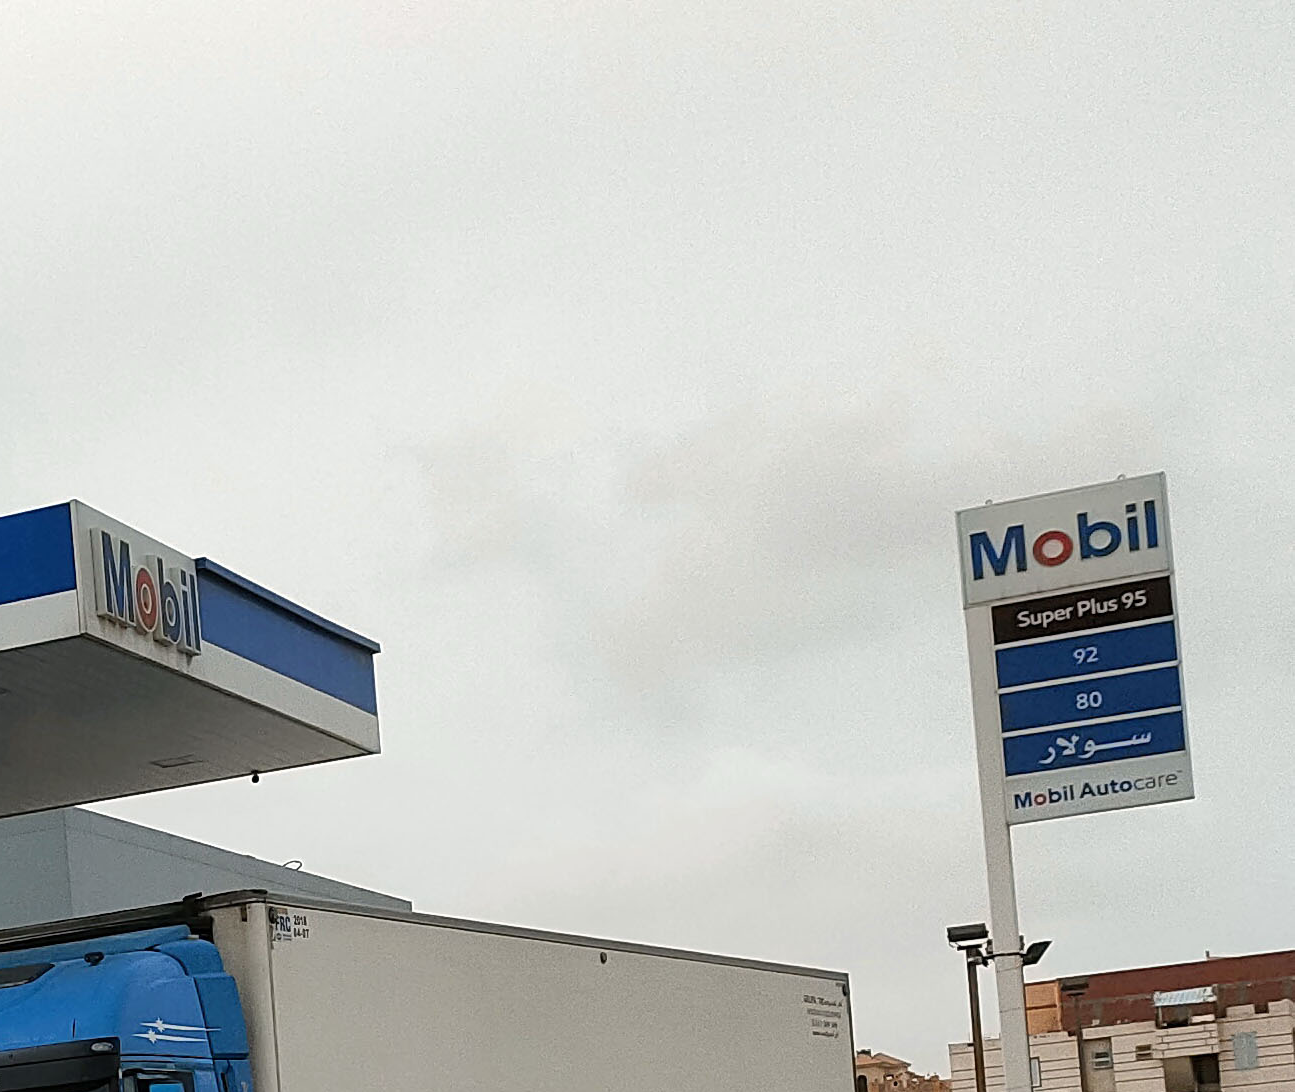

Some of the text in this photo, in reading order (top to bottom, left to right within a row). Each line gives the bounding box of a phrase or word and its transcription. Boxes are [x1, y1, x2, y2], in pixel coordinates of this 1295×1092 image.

[969, 500, 1158, 580] Mobil
[100, 529, 202, 654] Mobil
[1017, 590, 1147, 628] Super Plus 95
[1073, 646, 1099, 665] 92
[1076, 691, 1102, 709] 80
[1039, 732, 1152, 764] سولار
[1014, 785, 1074, 809] Mobil
